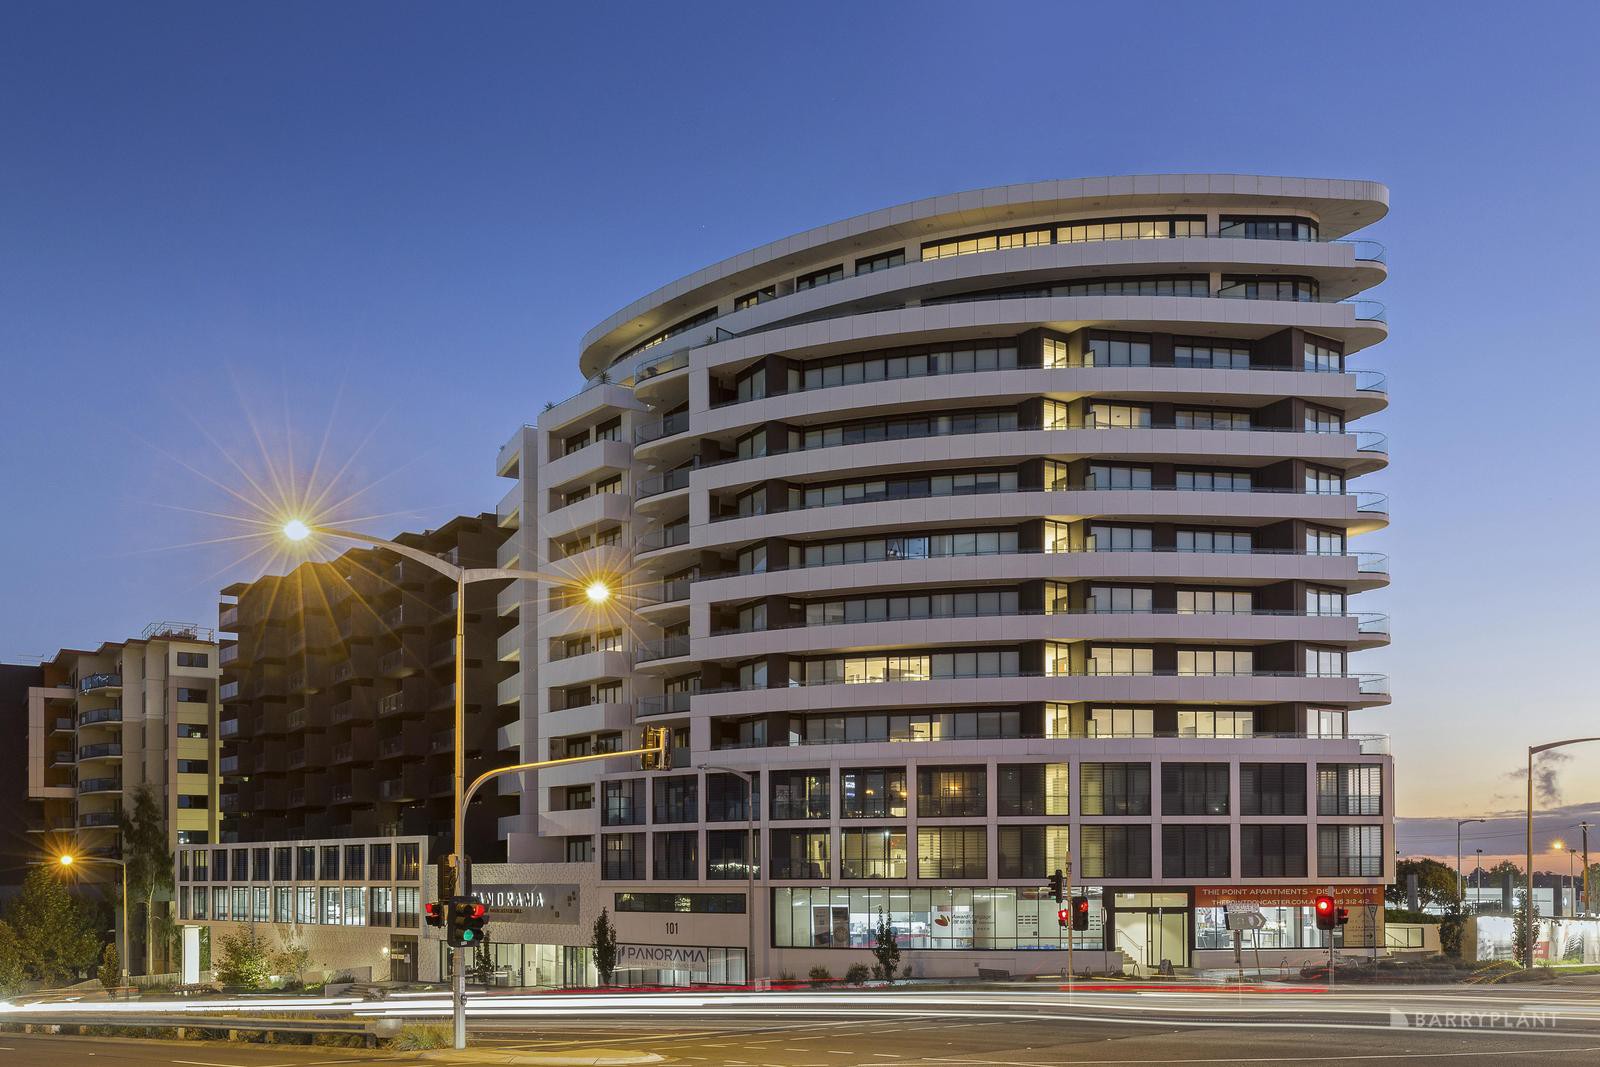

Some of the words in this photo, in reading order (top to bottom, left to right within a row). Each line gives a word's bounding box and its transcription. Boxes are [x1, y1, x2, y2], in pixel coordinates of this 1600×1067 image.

[1353, 887, 1378, 895] SUITE
[665, 922, 679, 935] 101
[628, 947, 706, 963] PANORAMA
